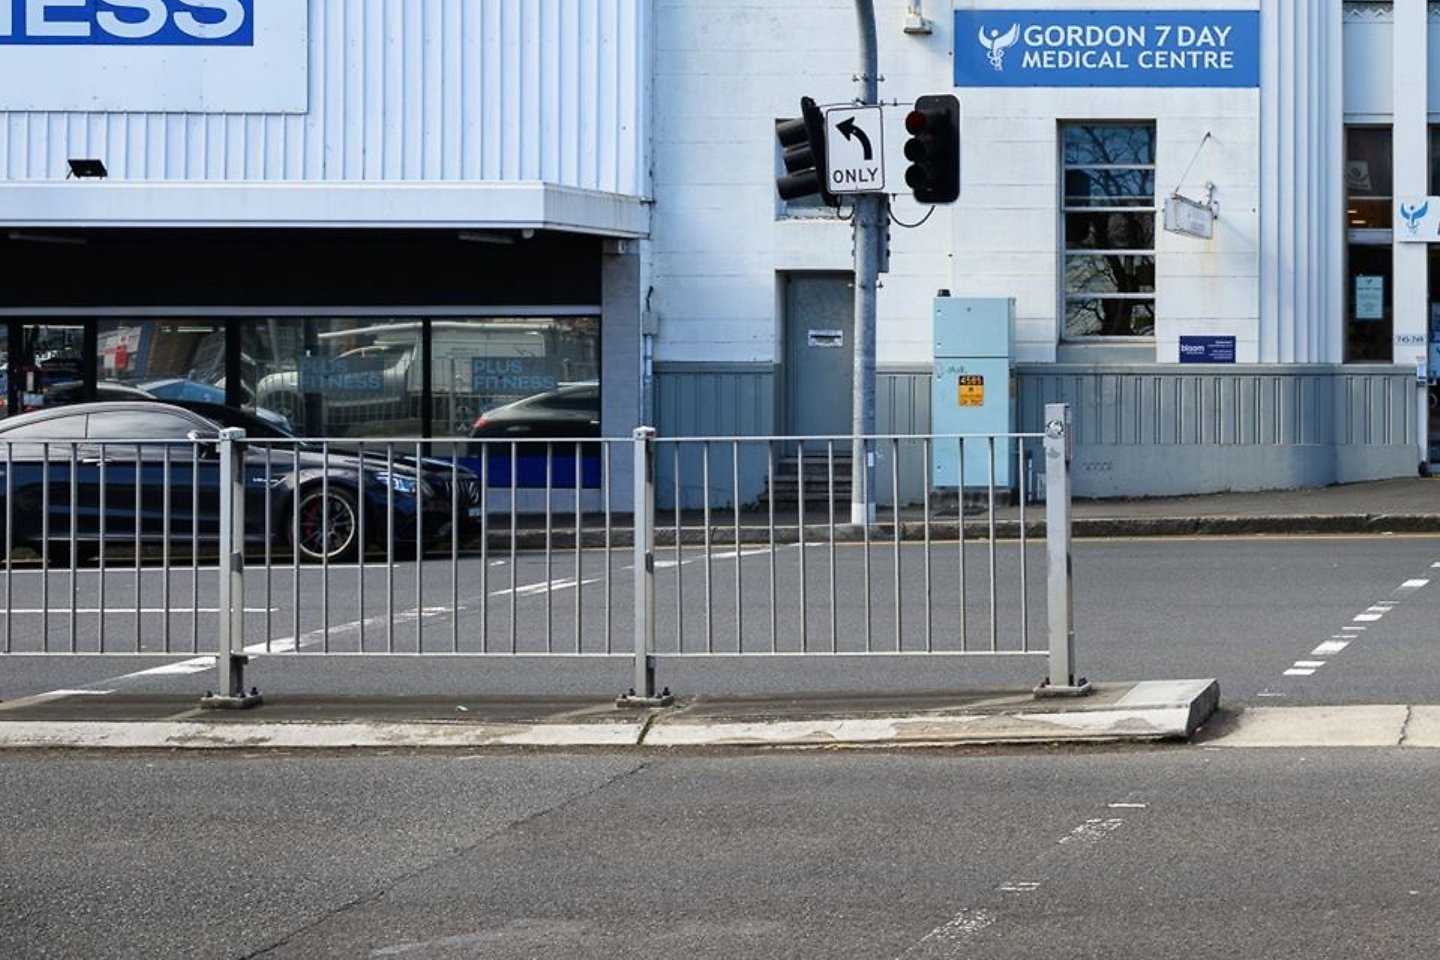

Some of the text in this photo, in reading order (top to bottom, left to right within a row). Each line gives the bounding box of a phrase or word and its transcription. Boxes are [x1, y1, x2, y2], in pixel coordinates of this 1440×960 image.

[1023, 25, 1232, 47] GORDON 7 DAY
[1022, 50, 1234, 69] MEDICAL CENTRE
[833, 167, 878, 184] ONLY
[1181, 344, 1205, 352] bloom
[302, 359, 348, 373] PLUS
[474, 359, 523, 374] PLUS
[301, 375, 381, 389] FITNESS
[474, 375, 557, 389] FITNESS
